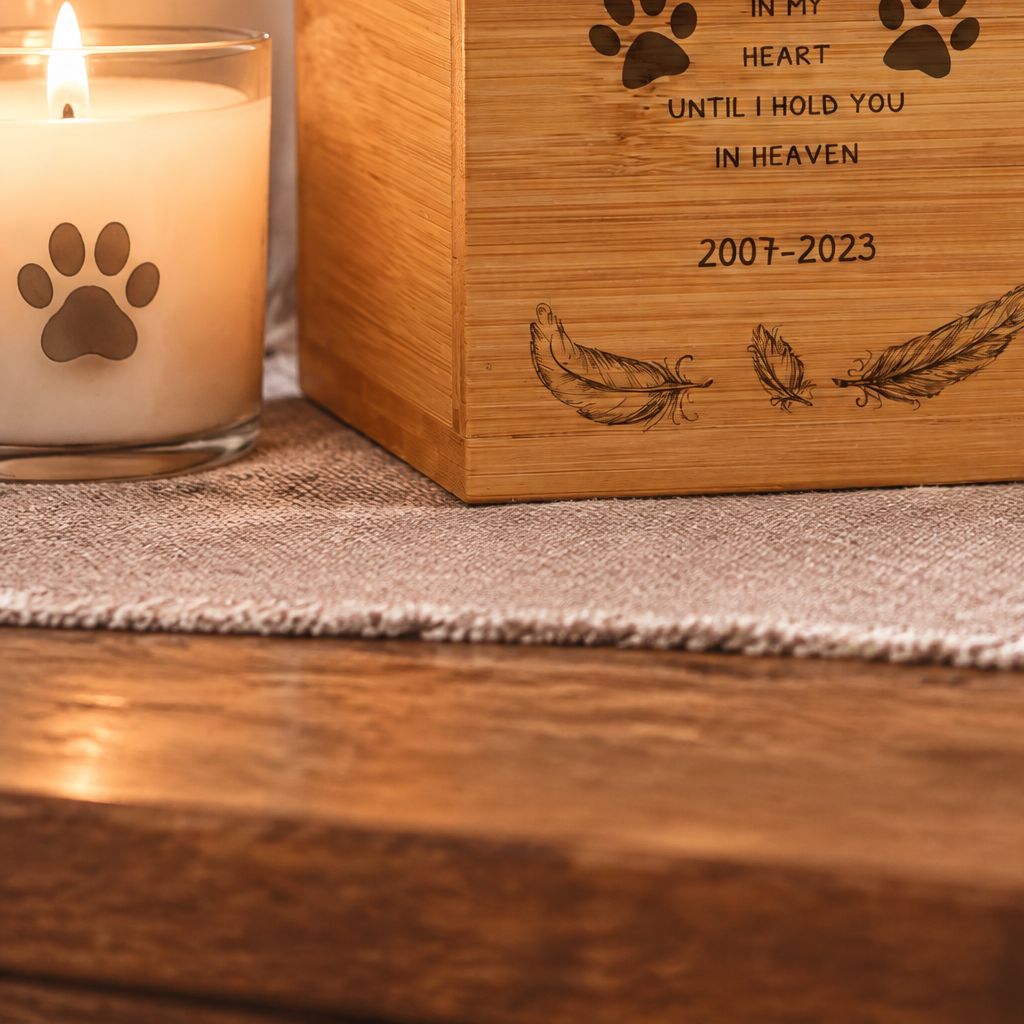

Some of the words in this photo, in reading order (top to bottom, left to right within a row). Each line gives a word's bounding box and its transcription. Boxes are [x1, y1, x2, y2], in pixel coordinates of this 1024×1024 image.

[742, 44, 831, 67] HEART
[667, 96, 746, 119] UNTIL
[756, 95, 761, 117] I
[772, 94, 839, 116] HOLD
[849, 92, 905, 114] YOU
[715, 146, 740, 169] IN
[752, 142, 859, 168] HEAVEN
[697, 232, 877, 268] 2007-2023
